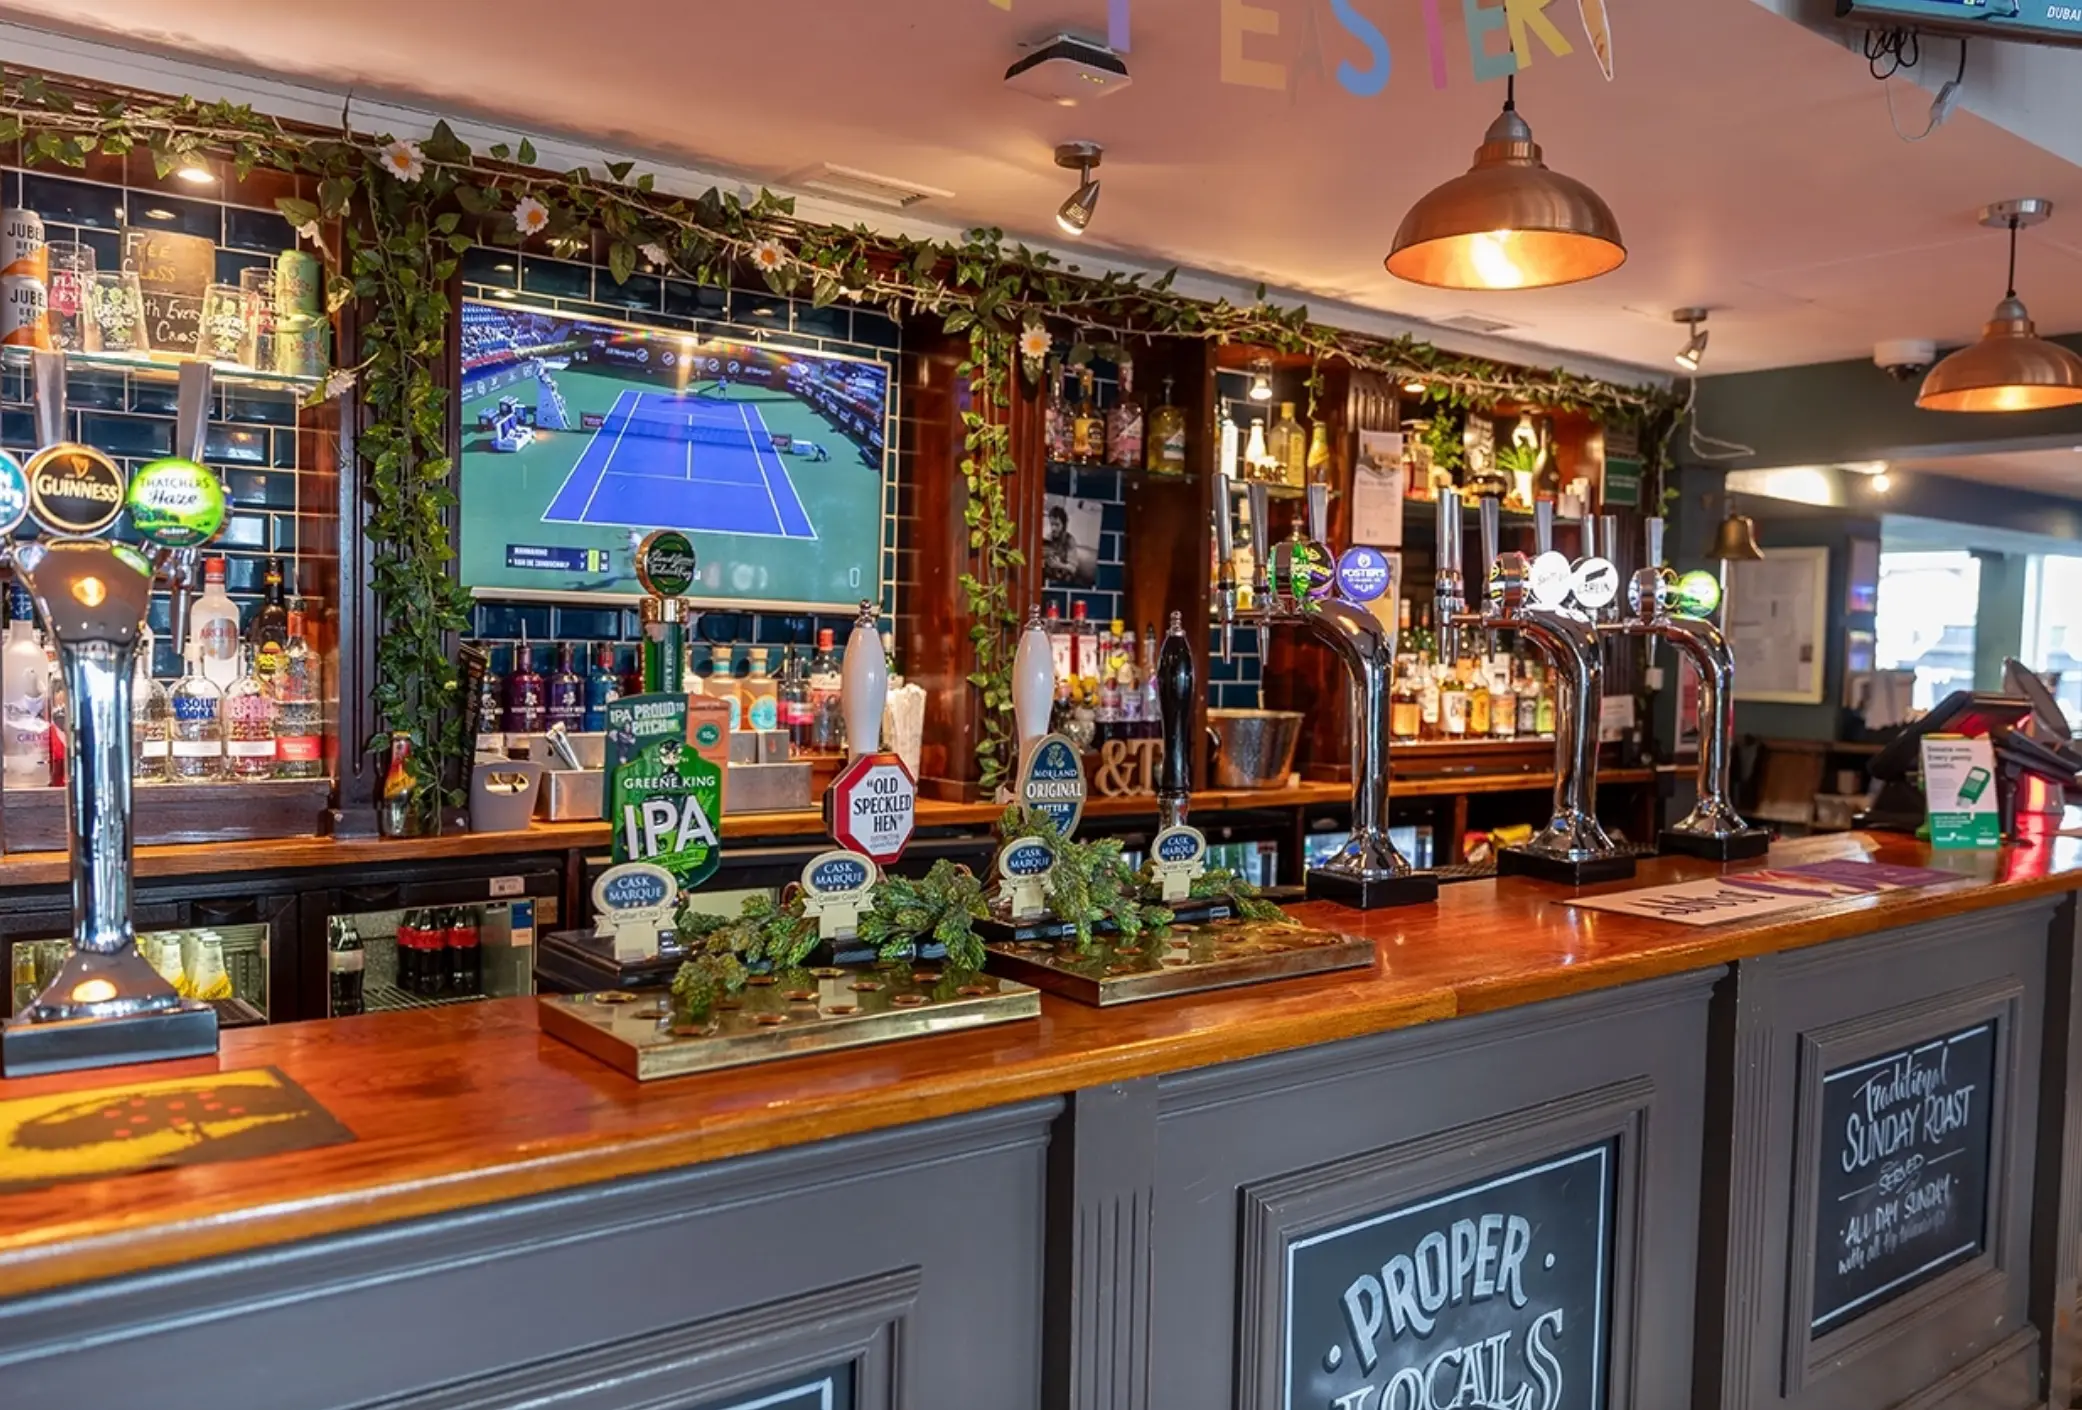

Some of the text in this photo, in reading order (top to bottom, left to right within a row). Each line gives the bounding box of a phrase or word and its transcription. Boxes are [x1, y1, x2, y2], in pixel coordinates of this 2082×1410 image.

[2047, 5, 2081, 21] DUBAI
[38, 475, 119, 502] GUINNESS
[149, 490, 198, 505] Haze
[610, 708, 632, 724] IPA
[633, 700, 676, 720] PROUD
[623, 775, 716, 789] GREENE KING
[1033, 769, 1078, 780] MORLAND
[1026, 782, 1083, 798] ORIGINAL
[853, 794, 912, 816] SPECKLED
[623, 795, 718, 861] IPA
[1167, 836, 1189, 846] CASK
[1017, 849, 1041, 859] CASK
[1161, 844, 1195, 856] MARQUE
[823, 863, 853, 874] CASK
[1010, 856, 1050, 868] MARQUE
[617, 876, 651, 889] CASK
[815, 872, 863, 885] MARQUE
[608, 886, 663, 901] MARQUE
[1853, 1046, 1949, 1122] Traditional
[1842, 1085, 1976, 1173] SUNDAY ROAST
[1879, 1154, 1925, 1196] SERVED
[1845, 1173, 1952, 1247] ALL DAY SUNDAY
[1343, 1213, 1531, 1376] PROPER
